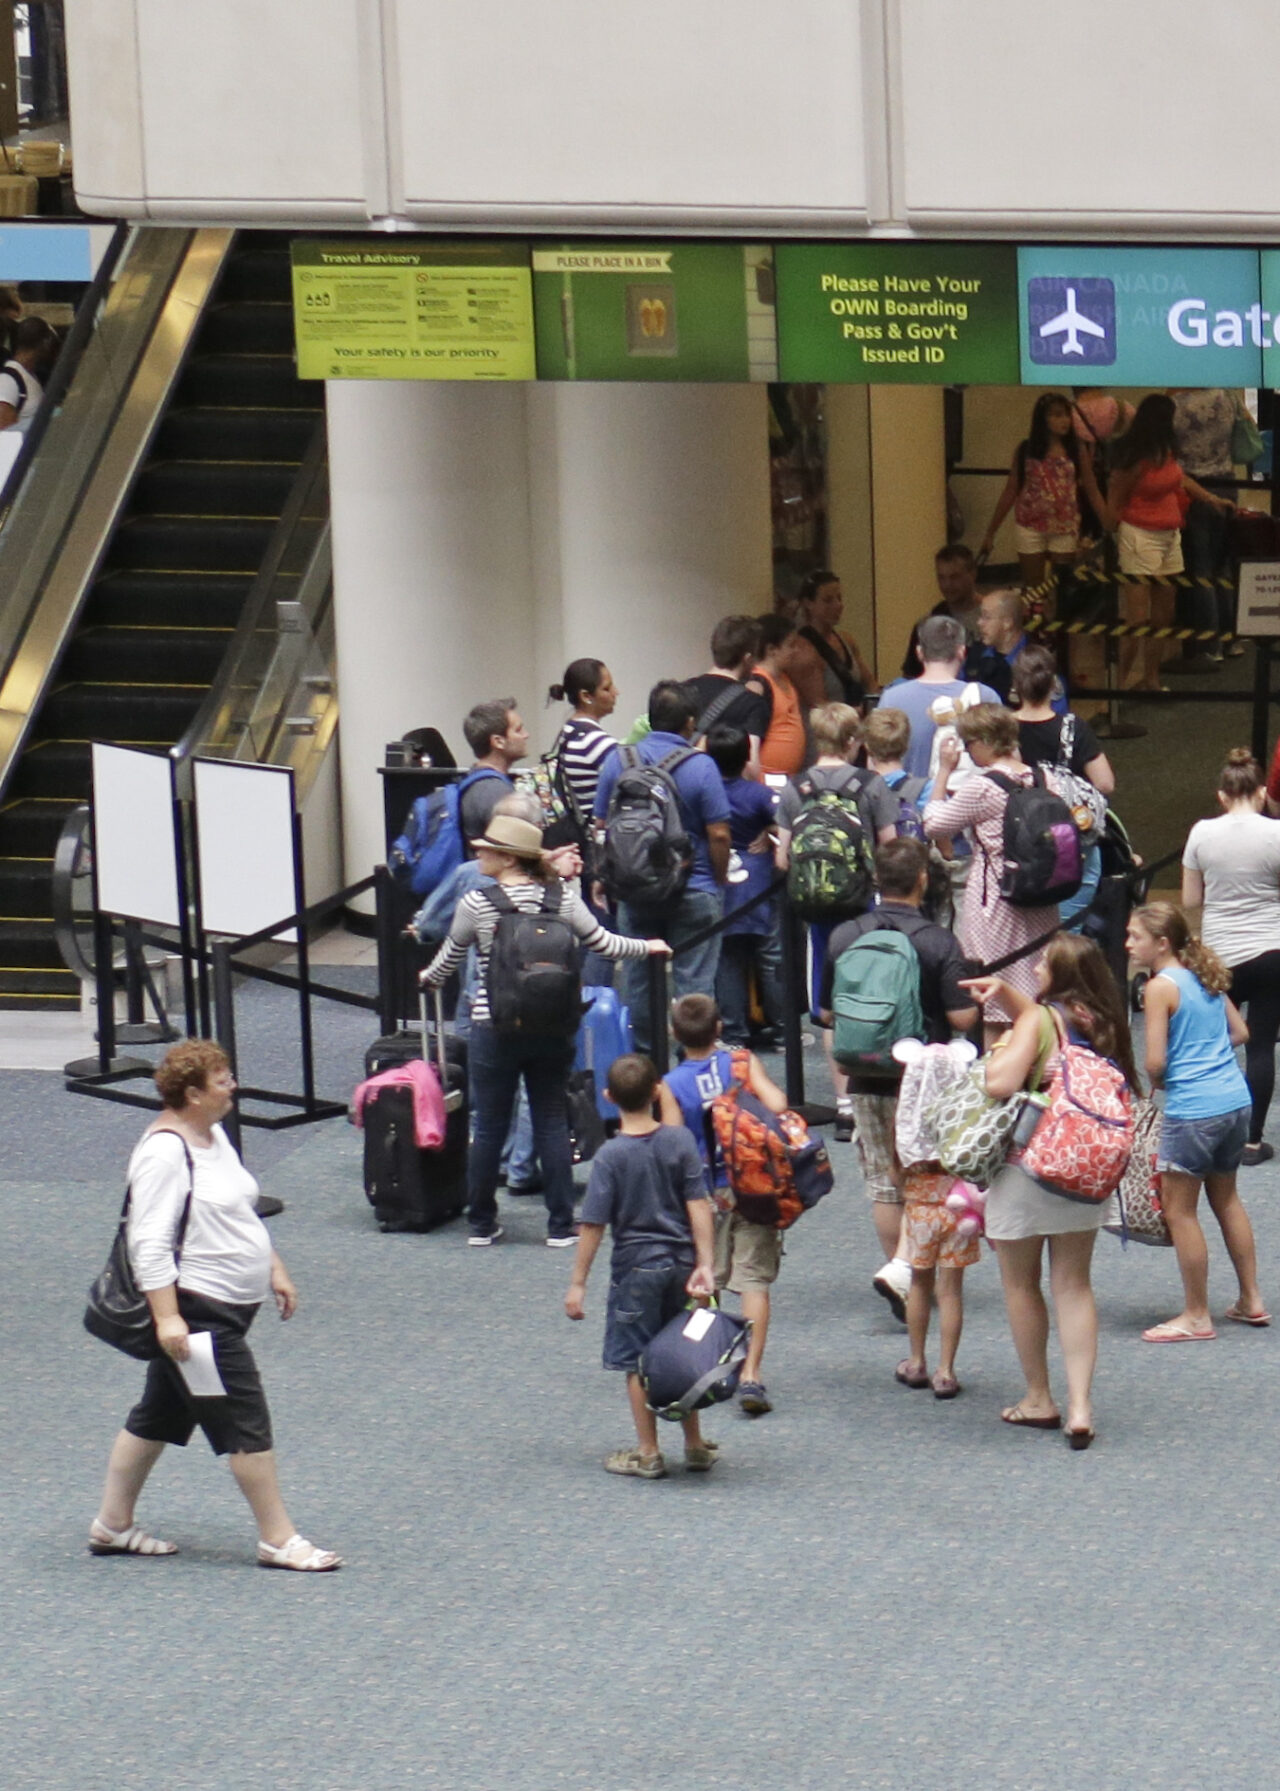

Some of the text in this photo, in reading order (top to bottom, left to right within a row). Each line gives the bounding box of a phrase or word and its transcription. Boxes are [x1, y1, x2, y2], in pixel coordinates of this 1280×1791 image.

[321, 253, 420, 265] Travel Advisory
[557, 256, 661, 268] PLEASE PLACE IN A BIN
[821, 275, 982, 293] Please Have Your
[830, 299, 968, 320] OWN Boarding
[843, 322, 958, 340] Pass & Gov't
[334, 346, 499, 360] Your safety is our priority
[862, 346, 945, 363] Issued ID
